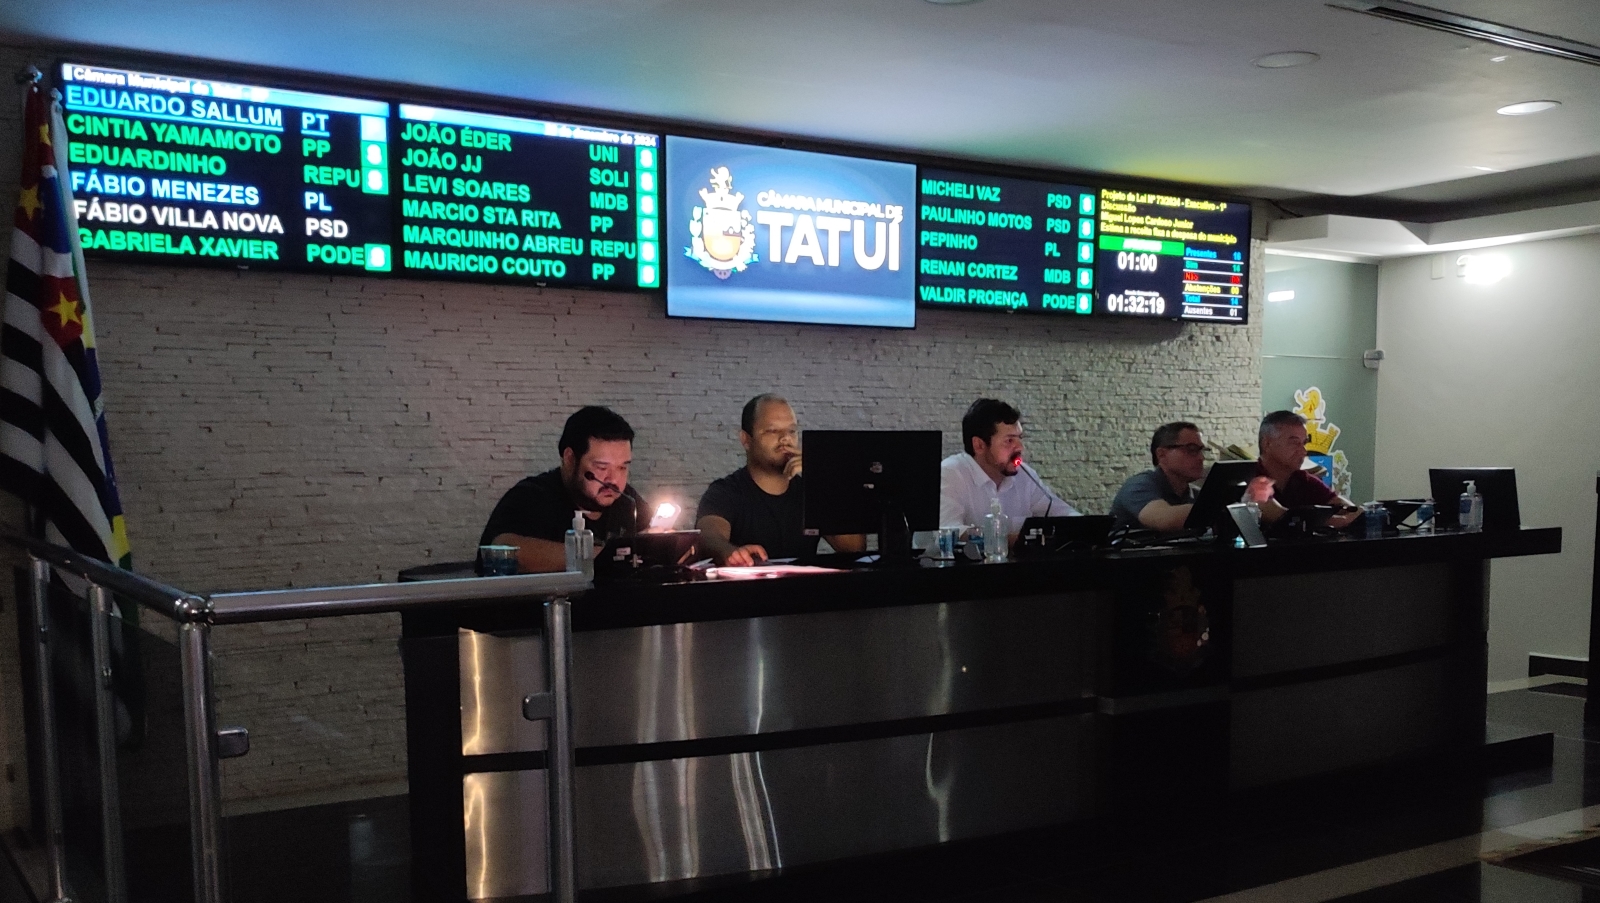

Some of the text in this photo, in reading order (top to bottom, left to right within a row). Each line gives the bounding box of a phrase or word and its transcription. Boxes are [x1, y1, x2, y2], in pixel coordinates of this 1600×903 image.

[66, 85, 185, 116] EDUARDO
[191, 100, 282, 127] SALLUM
[302, 112, 329, 132] PT
[67, 114, 331, 158] CINTIA YAMAMOTO PP
[401, 122, 456, 145] JOÃO
[460, 127, 512, 151] ÉDER
[589, 144, 619, 163] UNI
[69, 142, 227, 175] EDUARDINHO
[304, 164, 360, 188] REPU
[401, 147, 457, 170] JOÃO
[460, 154, 482, 173] JJ
[589, 167, 629, 187] SOLI
[70, 169, 332, 211] FÁBIO MENEZES PL
[403, 173, 447, 195] LEVI
[452, 177, 531, 203] SOARES
[590, 191, 628, 210] MDB
[757, 189, 903, 219] CÂMARA MUNICIPAL DE
[921, 179, 974, 200] MICHELI
[976, 185, 1001, 202] VAZ
[1047, 193, 1071, 209] PSD
[1101, 189, 1126, 201] Projeto
[1136, 192, 1147, 203] Lei
[1185, 198, 1216, 211] Executivo
[73, 197, 348, 238] FÁBIO VILLA NOVA PSD
[402, 199, 613, 233] MARCIO STA RITA PP
[921, 205, 985, 226] PAULINHO
[988, 212, 1032, 230] MOTOS
[1046, 218, 1071, 234] PSD
[1101, 200, 1137, 213] Discussão
[1101, 211, 1123, 223] Miguel
[1124, 213, 1144, 225] Lopes
[1145, 215, 1173, 227] Cardoso
[403, 225, 519, 251] MARQUINHO
[522, 234, 584, 255] ABREU
[590, 239, 636, 259] REPU
[757, 210, 902, 271] TATUÍ
[921, 231, 978, 250] PEPINHO
[1045, 242, 1061, 257] PL
[1101, 222, 1124, 233] Estima
[1130, 226, 1152, 236] receita
[1171, 229, 1197, 241] despesa
[78, 228, 196, 255] GABRIELA
[199, 236, 279, 260] XAVIER
[306, 243, 364, 266] PODE
[1117, 251, 1158, 272] 01:00
[1185, 247, 1217, 259] Presentes
[404, 250, 498, 274] MAURICIO
[502, 256, 566, 278] COUTO
[592, 262, 615, 280] PP
[920, 259, 965, 276] RENAN
[967, 262, 1018, 280] CORTEZ
[1044, 268, 1071, 284] MDB
[1185, 260, 1198, 269] Sim
[920, 286, 966, 303] VALDIR
[968, 289, 1028, 309] PROENÇA
[1043, 294, 1076, 309] PODE
[1107, 293, 1165, 314] 01:32:19
[1184, 305, 1238, 317] Ausentes 01
[1185, 294, 1239, 305] Total 14
